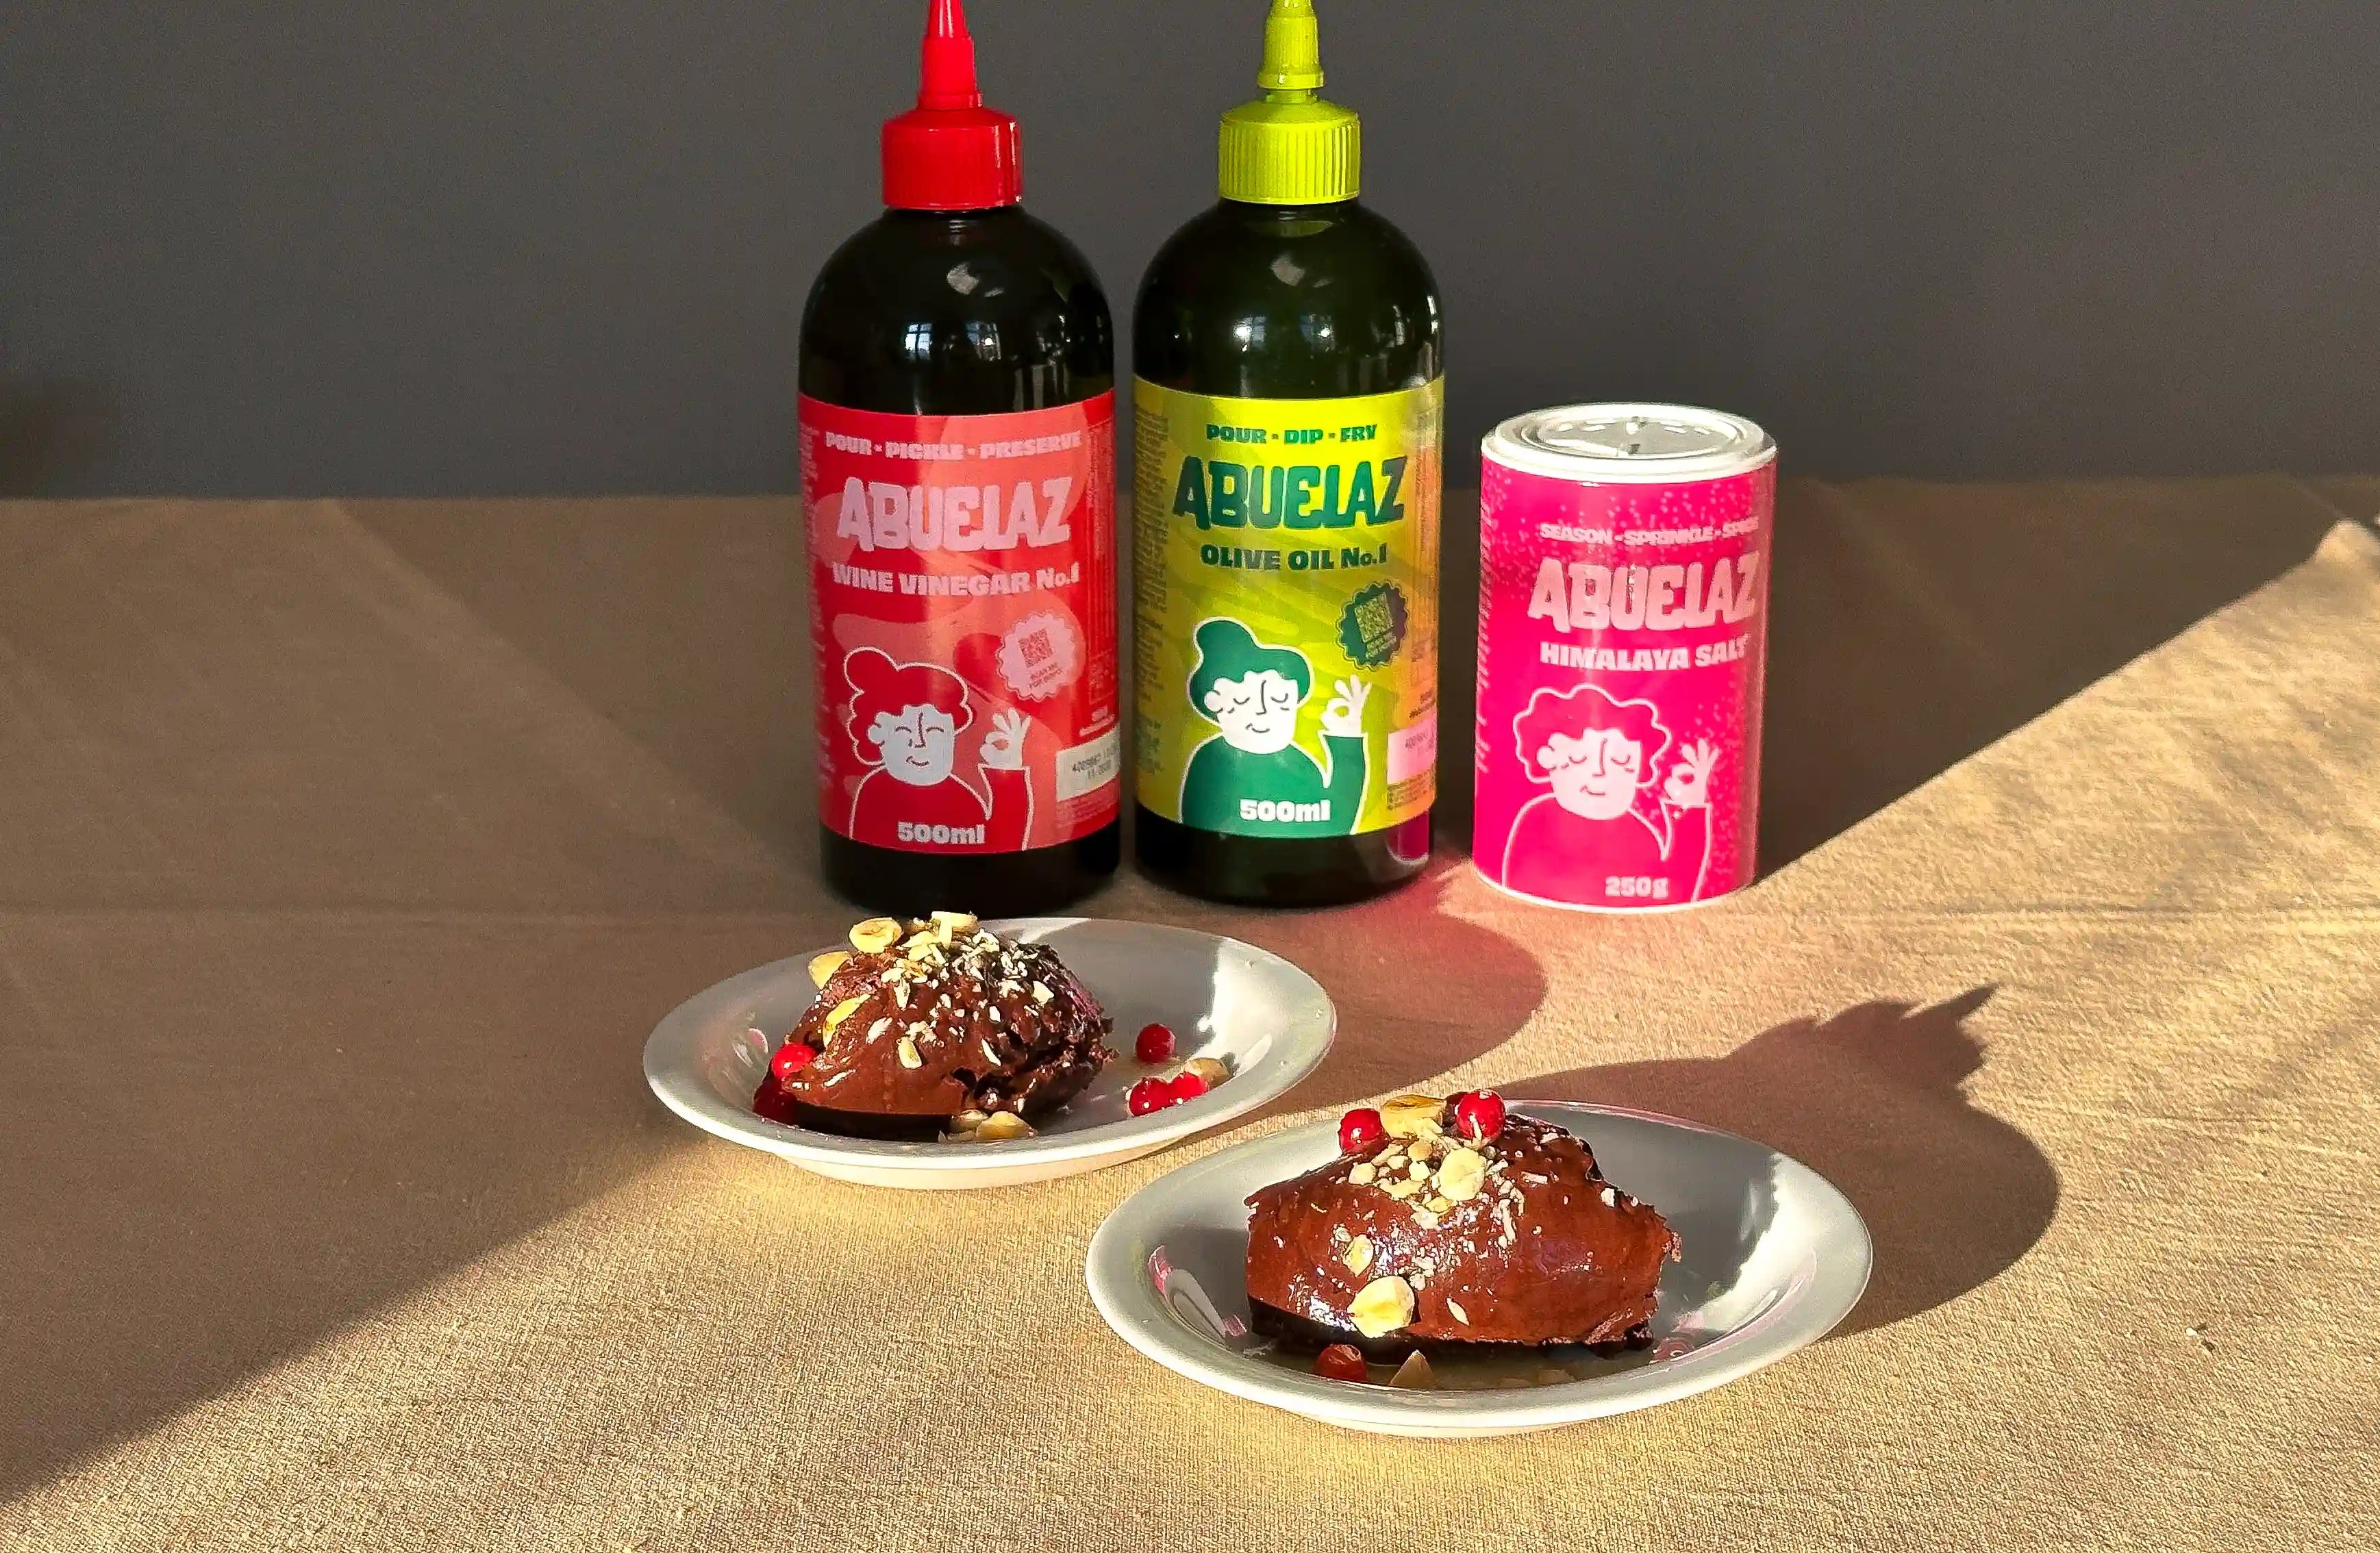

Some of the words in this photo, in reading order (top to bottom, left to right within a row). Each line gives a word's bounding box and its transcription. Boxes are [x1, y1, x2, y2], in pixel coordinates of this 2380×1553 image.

[826, 431, 873, 456] POUR
[886, 441, 964, 459] PICKLE
[979, 430, 1082, 458] PRESERVE
[1206, 424, 1267, 444] POUR
[1284, 429, 1323, 444] DIP
[1340, 424, 1377, 442] FRY
[1173, 455, 1407, 531] ABUELAZ
[836, 477, 1072, 551] ABUELAZ
[1540, 522, 1614, 545] SEASON
[1623, 527, 1713, 546] SPRINKLE
[1201, 544, 1280, 570] OLIVE
[1288, 550, 1334, 570] OIL
[832, 563, 893, 593] WINE
[899, 572, 1031, 596] VINEGAR
[1527, 551, 1759, 633] ABUELAZ
[1540, 641, 1690, 671] HIMALAYA
[1695, 633, 1750, 667] SALT
[1240, 799, 1331, 822] 500ml
[898, 822, 986, 844] 500ml
[1605, 876, 1668, 898] 250g
